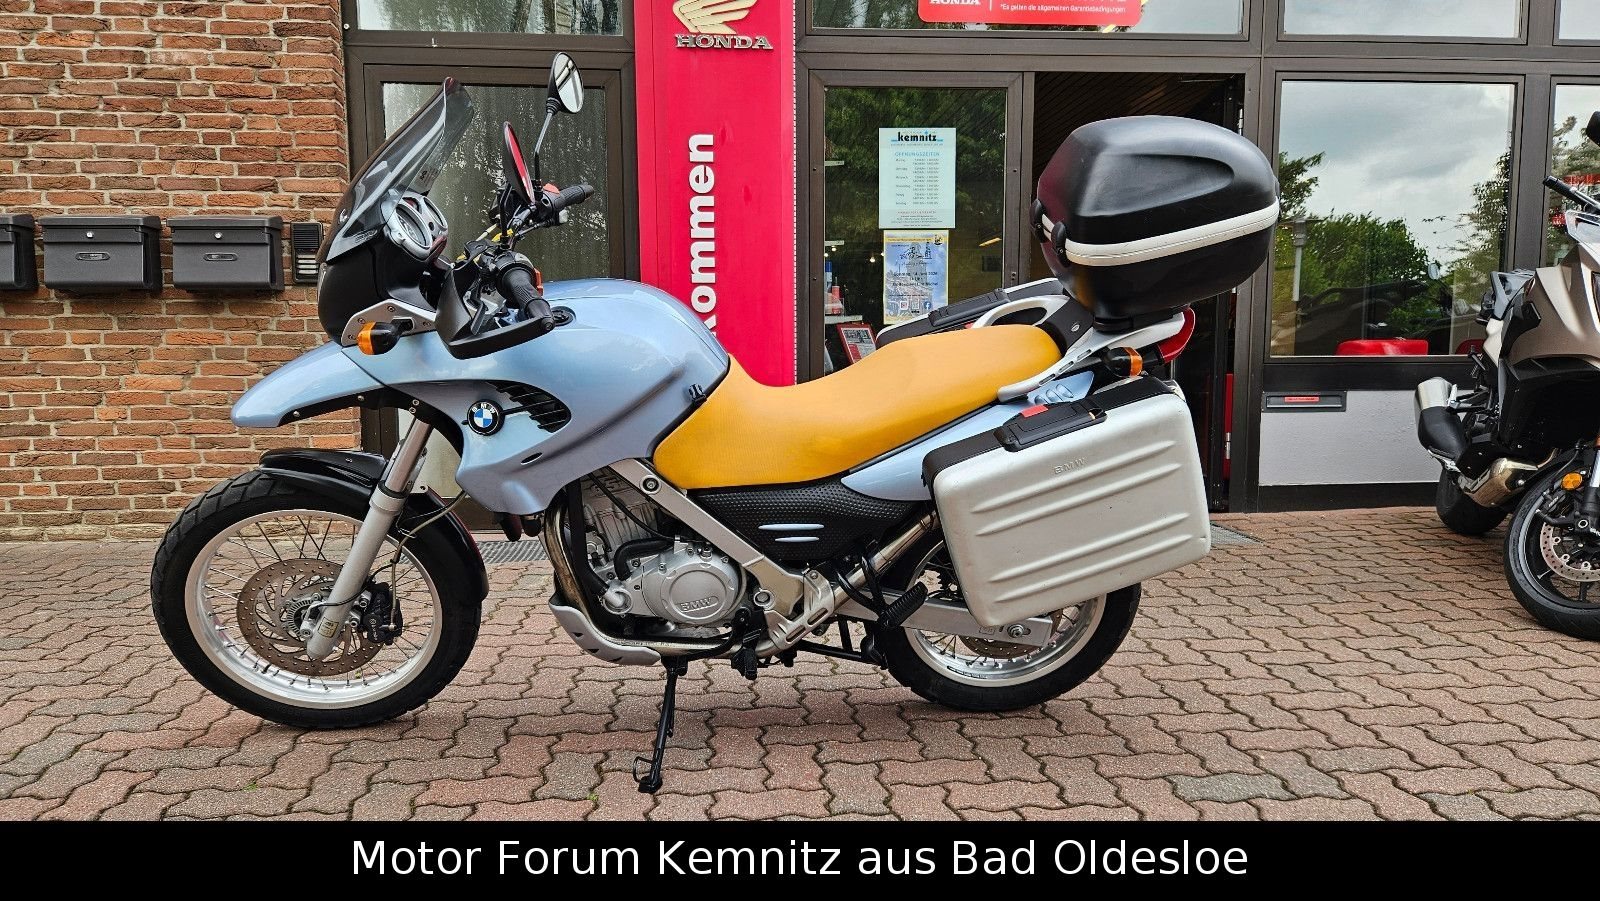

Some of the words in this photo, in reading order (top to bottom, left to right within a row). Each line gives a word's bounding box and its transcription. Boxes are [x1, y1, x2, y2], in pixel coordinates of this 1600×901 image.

[675, 33, 774, 50] HONDA
[897, 131, 937, 142] kemnitz
[471, 402, 497, 414] BMW
[1054, 456, 1087, 475] BMW
[680, 597, 711, 611] BMW
